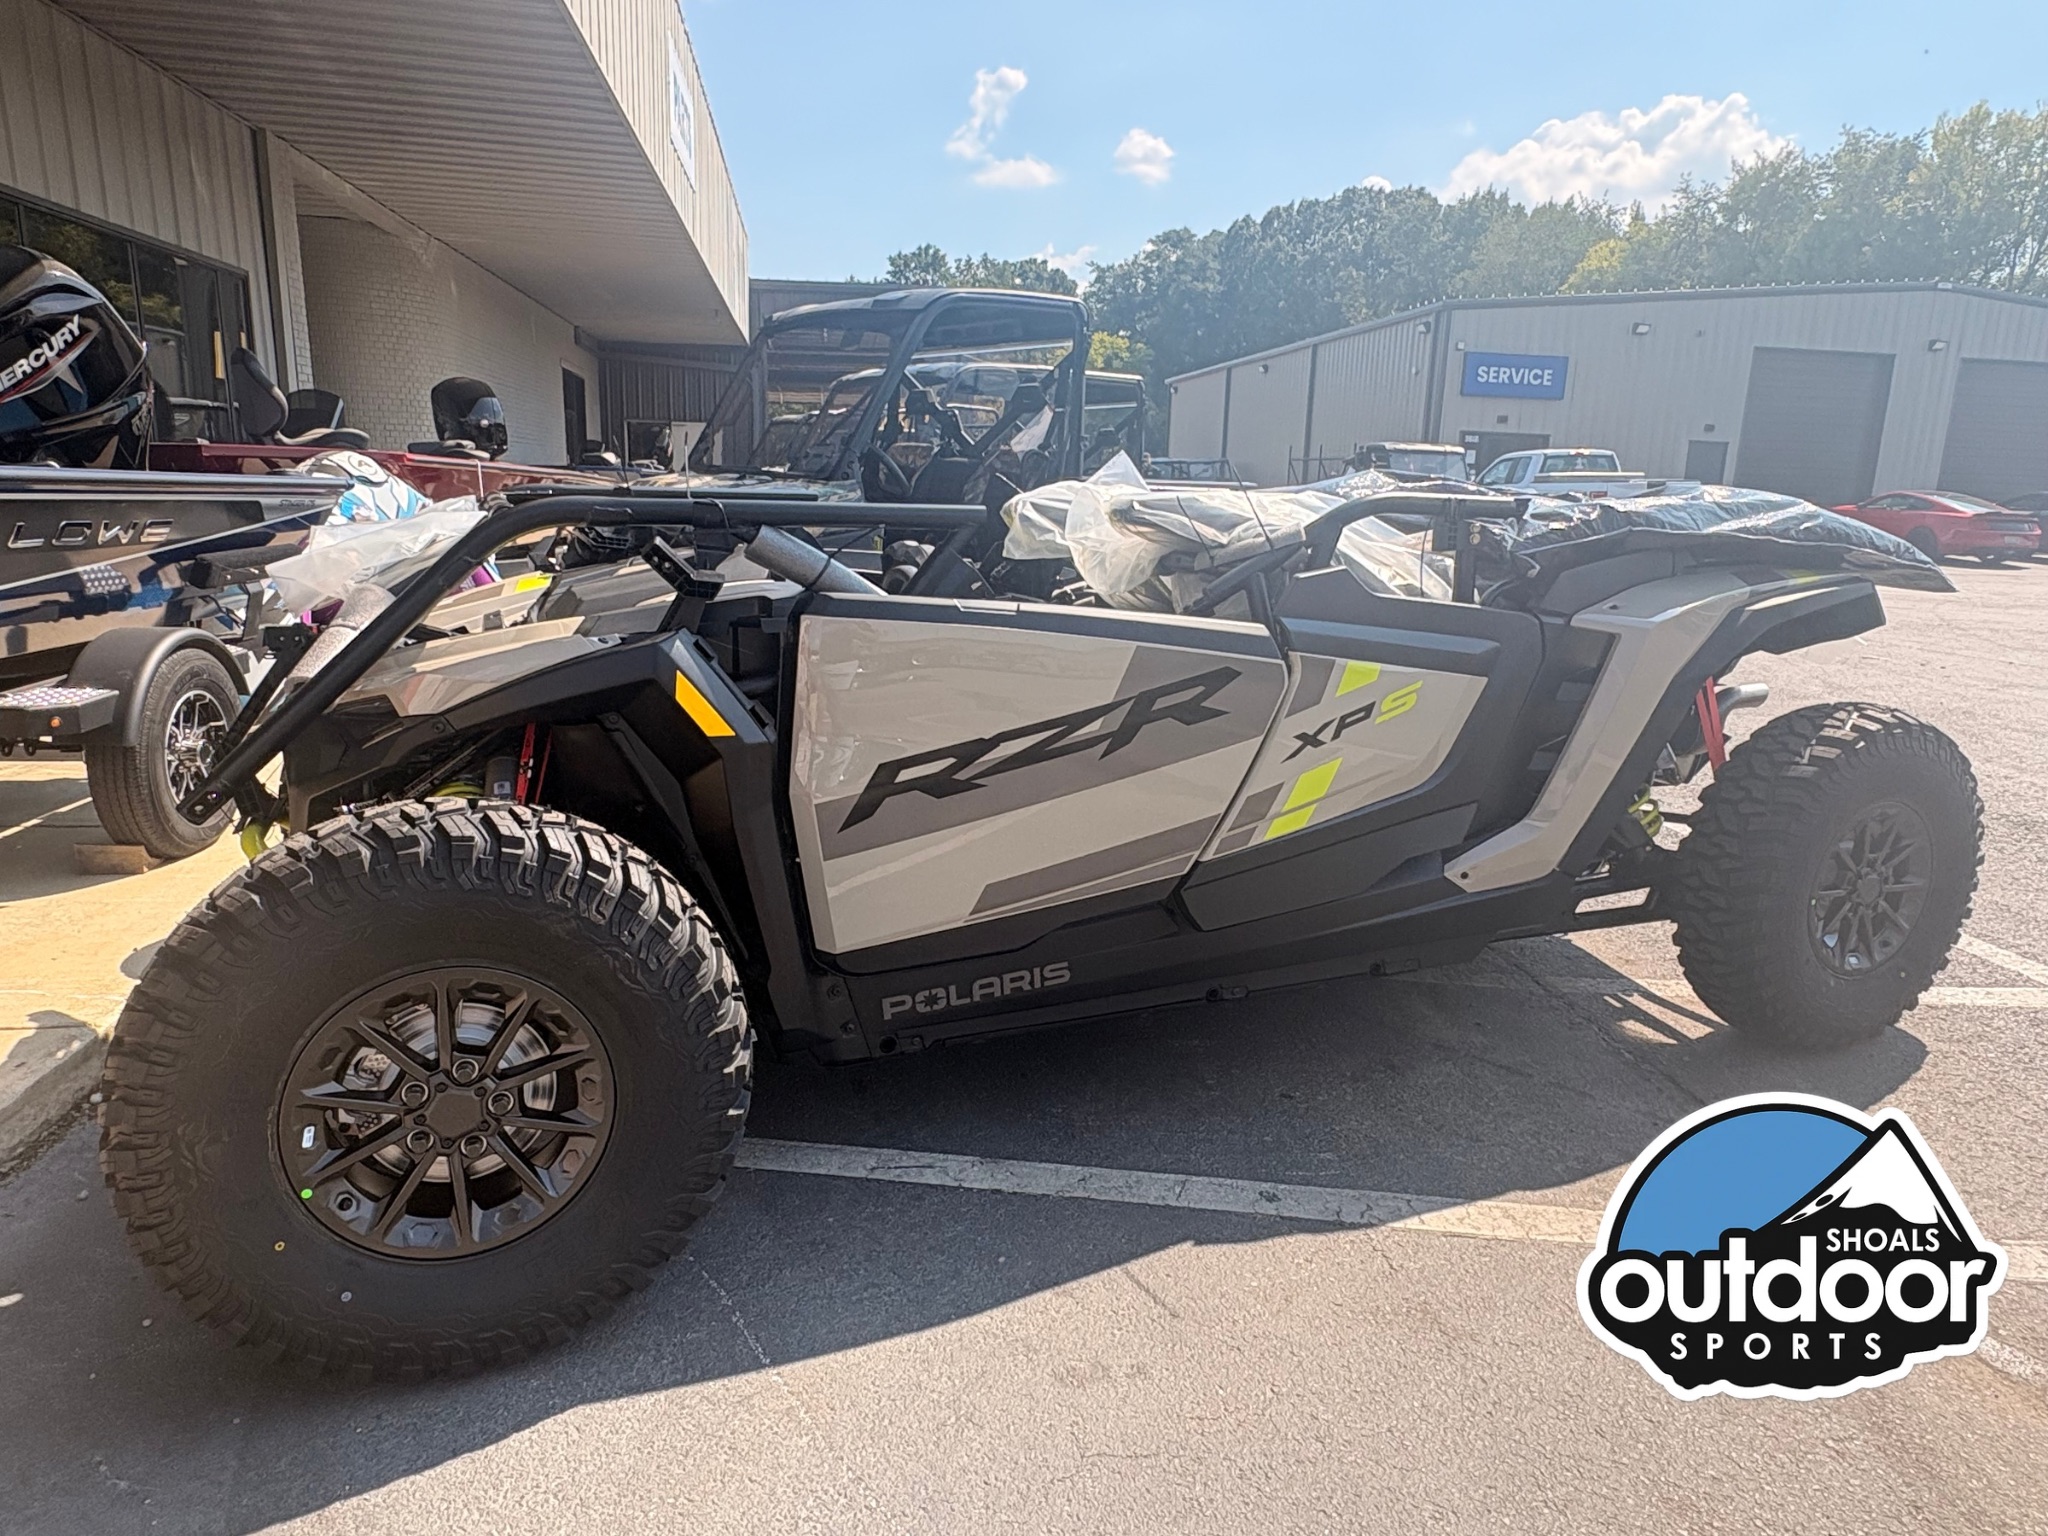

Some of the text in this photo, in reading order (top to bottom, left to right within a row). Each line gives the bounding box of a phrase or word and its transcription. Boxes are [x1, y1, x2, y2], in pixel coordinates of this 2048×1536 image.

[1477, 366, 1553, 386] SERVICE
[7, 519, 174, 549] LOWE
[838, 666, 1243, 834] RZR
[881, 961, 1071, 1021] POLARIS
